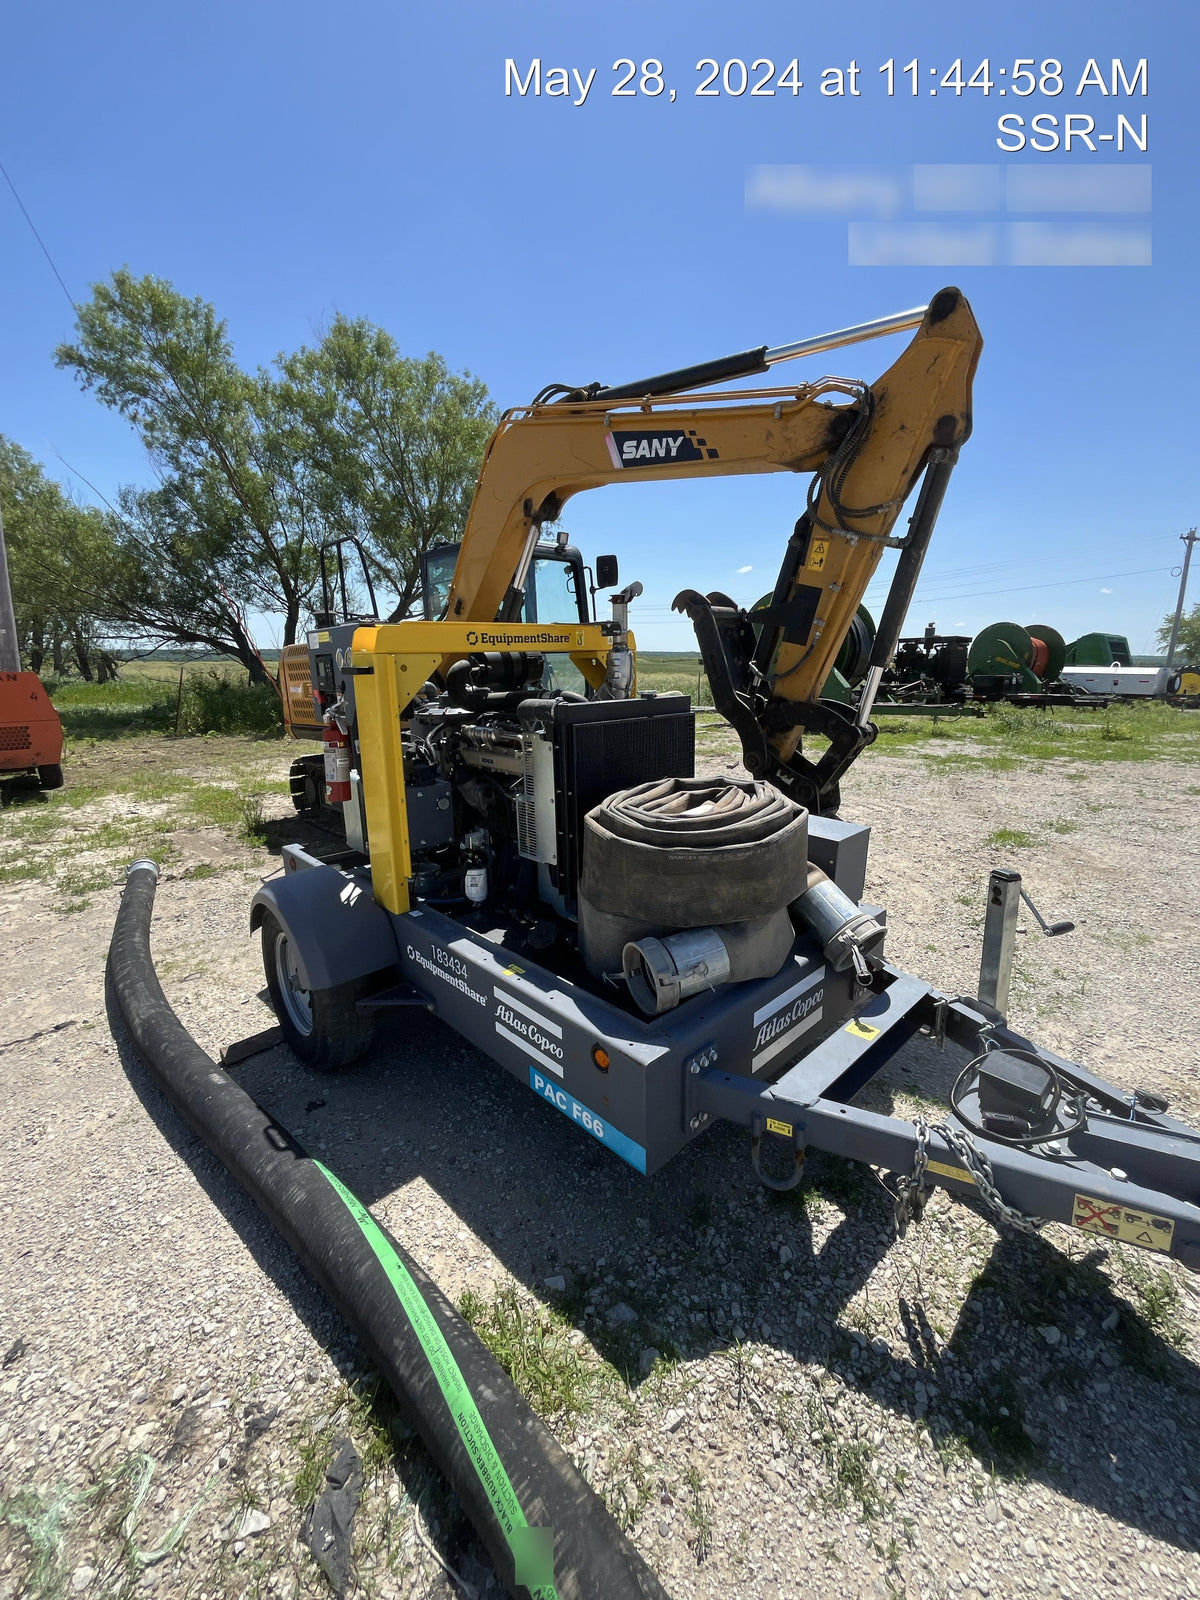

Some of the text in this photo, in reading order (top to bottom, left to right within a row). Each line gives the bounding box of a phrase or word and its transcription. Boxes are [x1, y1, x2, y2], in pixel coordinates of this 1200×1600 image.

[622, 436, 684, 460] SANY
[480, 632, 570, 646] EquipmentShare
[415, 950, 487, 1007] EquipmentShare
[431, 944, 468, 980] 183434
[494, 1004, 564, 1059] Atlas Copco
[752, 988, 824, 1052] Atlas Copco
[534, 1073, 604, 1138] PAC F66
[468, 1410, 495, 1461] DISCHARGE
[457, 1412, 513, 1535] BLACK RUBBER SUCTION
[494, 1469, 517, 1516] SUCTION
